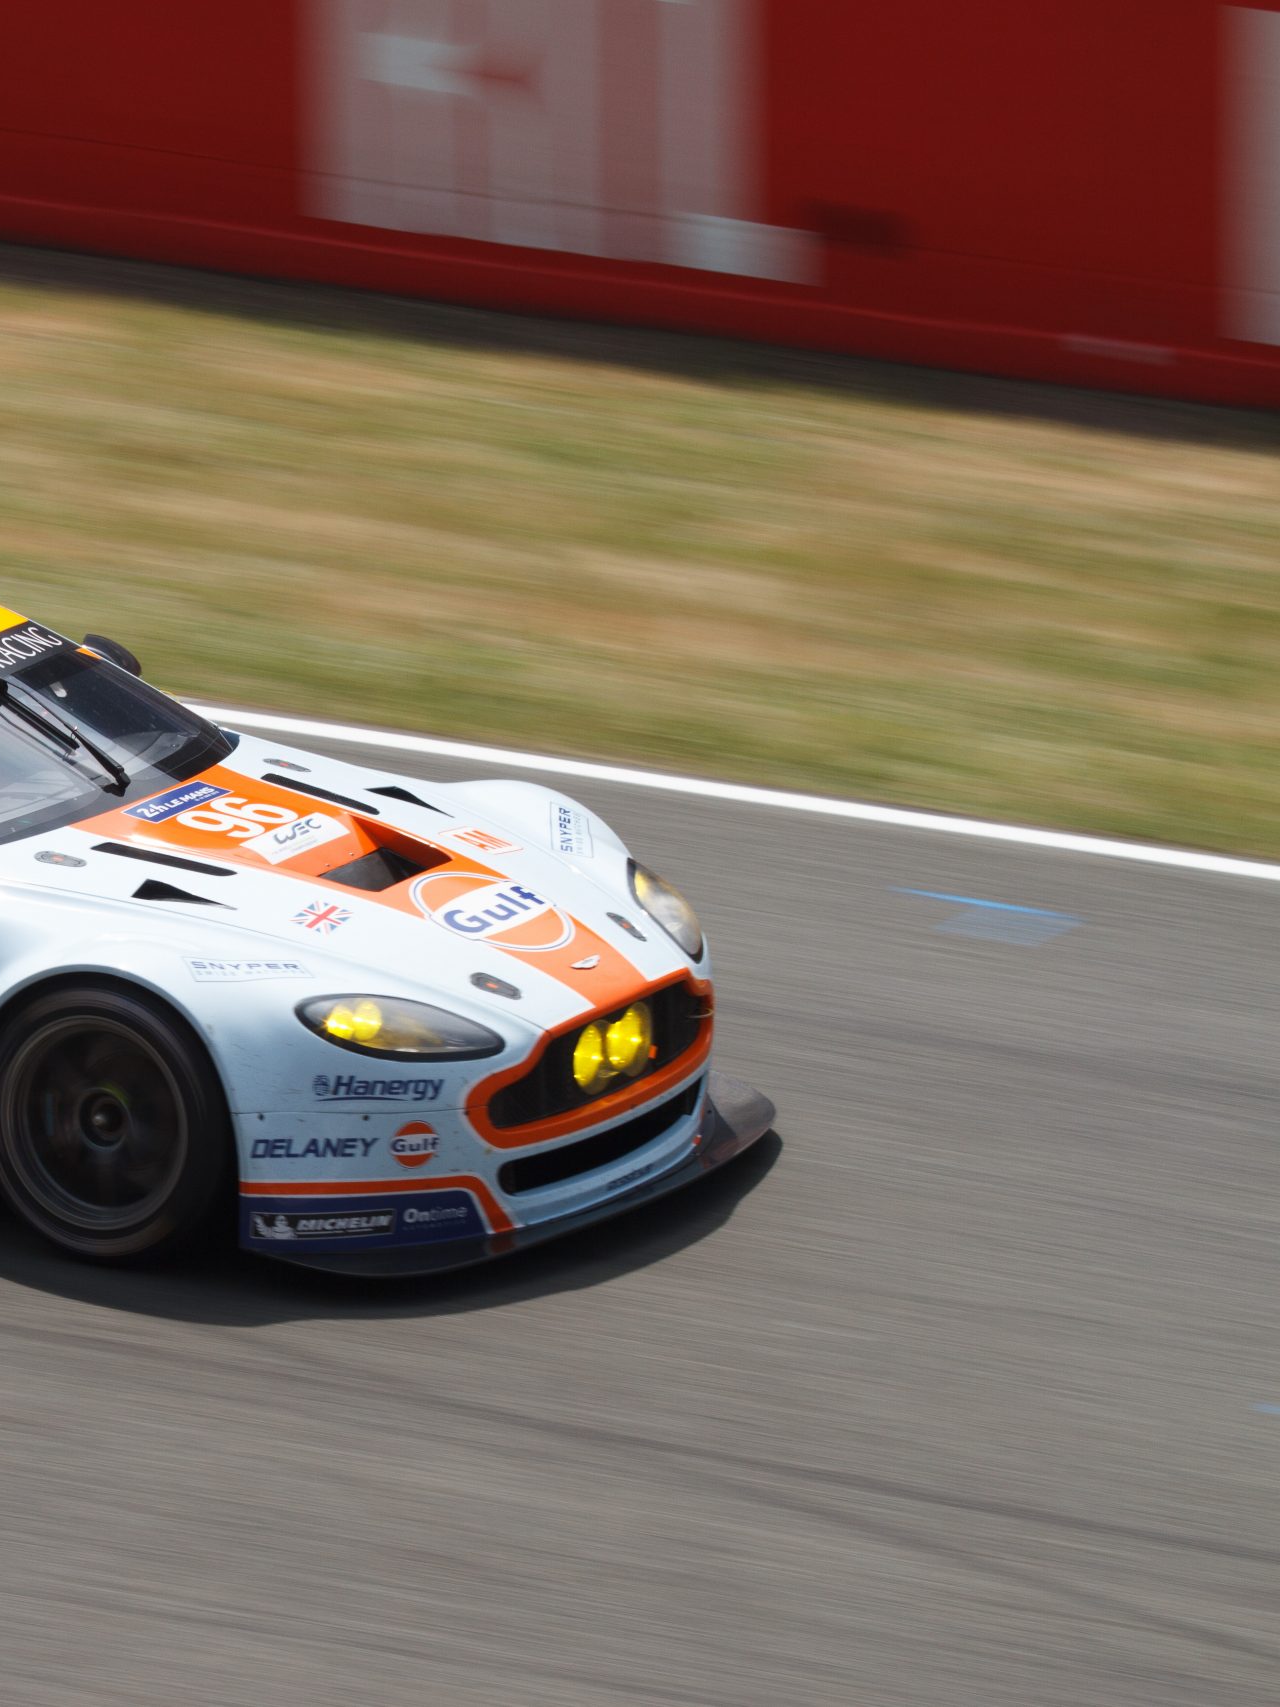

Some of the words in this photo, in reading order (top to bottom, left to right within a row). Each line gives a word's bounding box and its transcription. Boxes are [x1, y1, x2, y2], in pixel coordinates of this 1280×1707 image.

[165, 799, 183, 809] LE
[182, 787, 217, 803] MANS
[176, 797, 299, 838] 96
[273, 818, 322, 845] WEC
[453, 830, 513, 851] AM
[559, 807, 573, 852] SNYPER
[444, 886, 545, 933] Gulf
[191, 961, 300, 970] SNYPER
[332, 1075, 445, 1101] Hanergy
[251, 1138, 380, 1159] DELANEY
[391, 1137, 440, 1153] Gulf
[296, 1215, 393, 1231] MICHELIN
